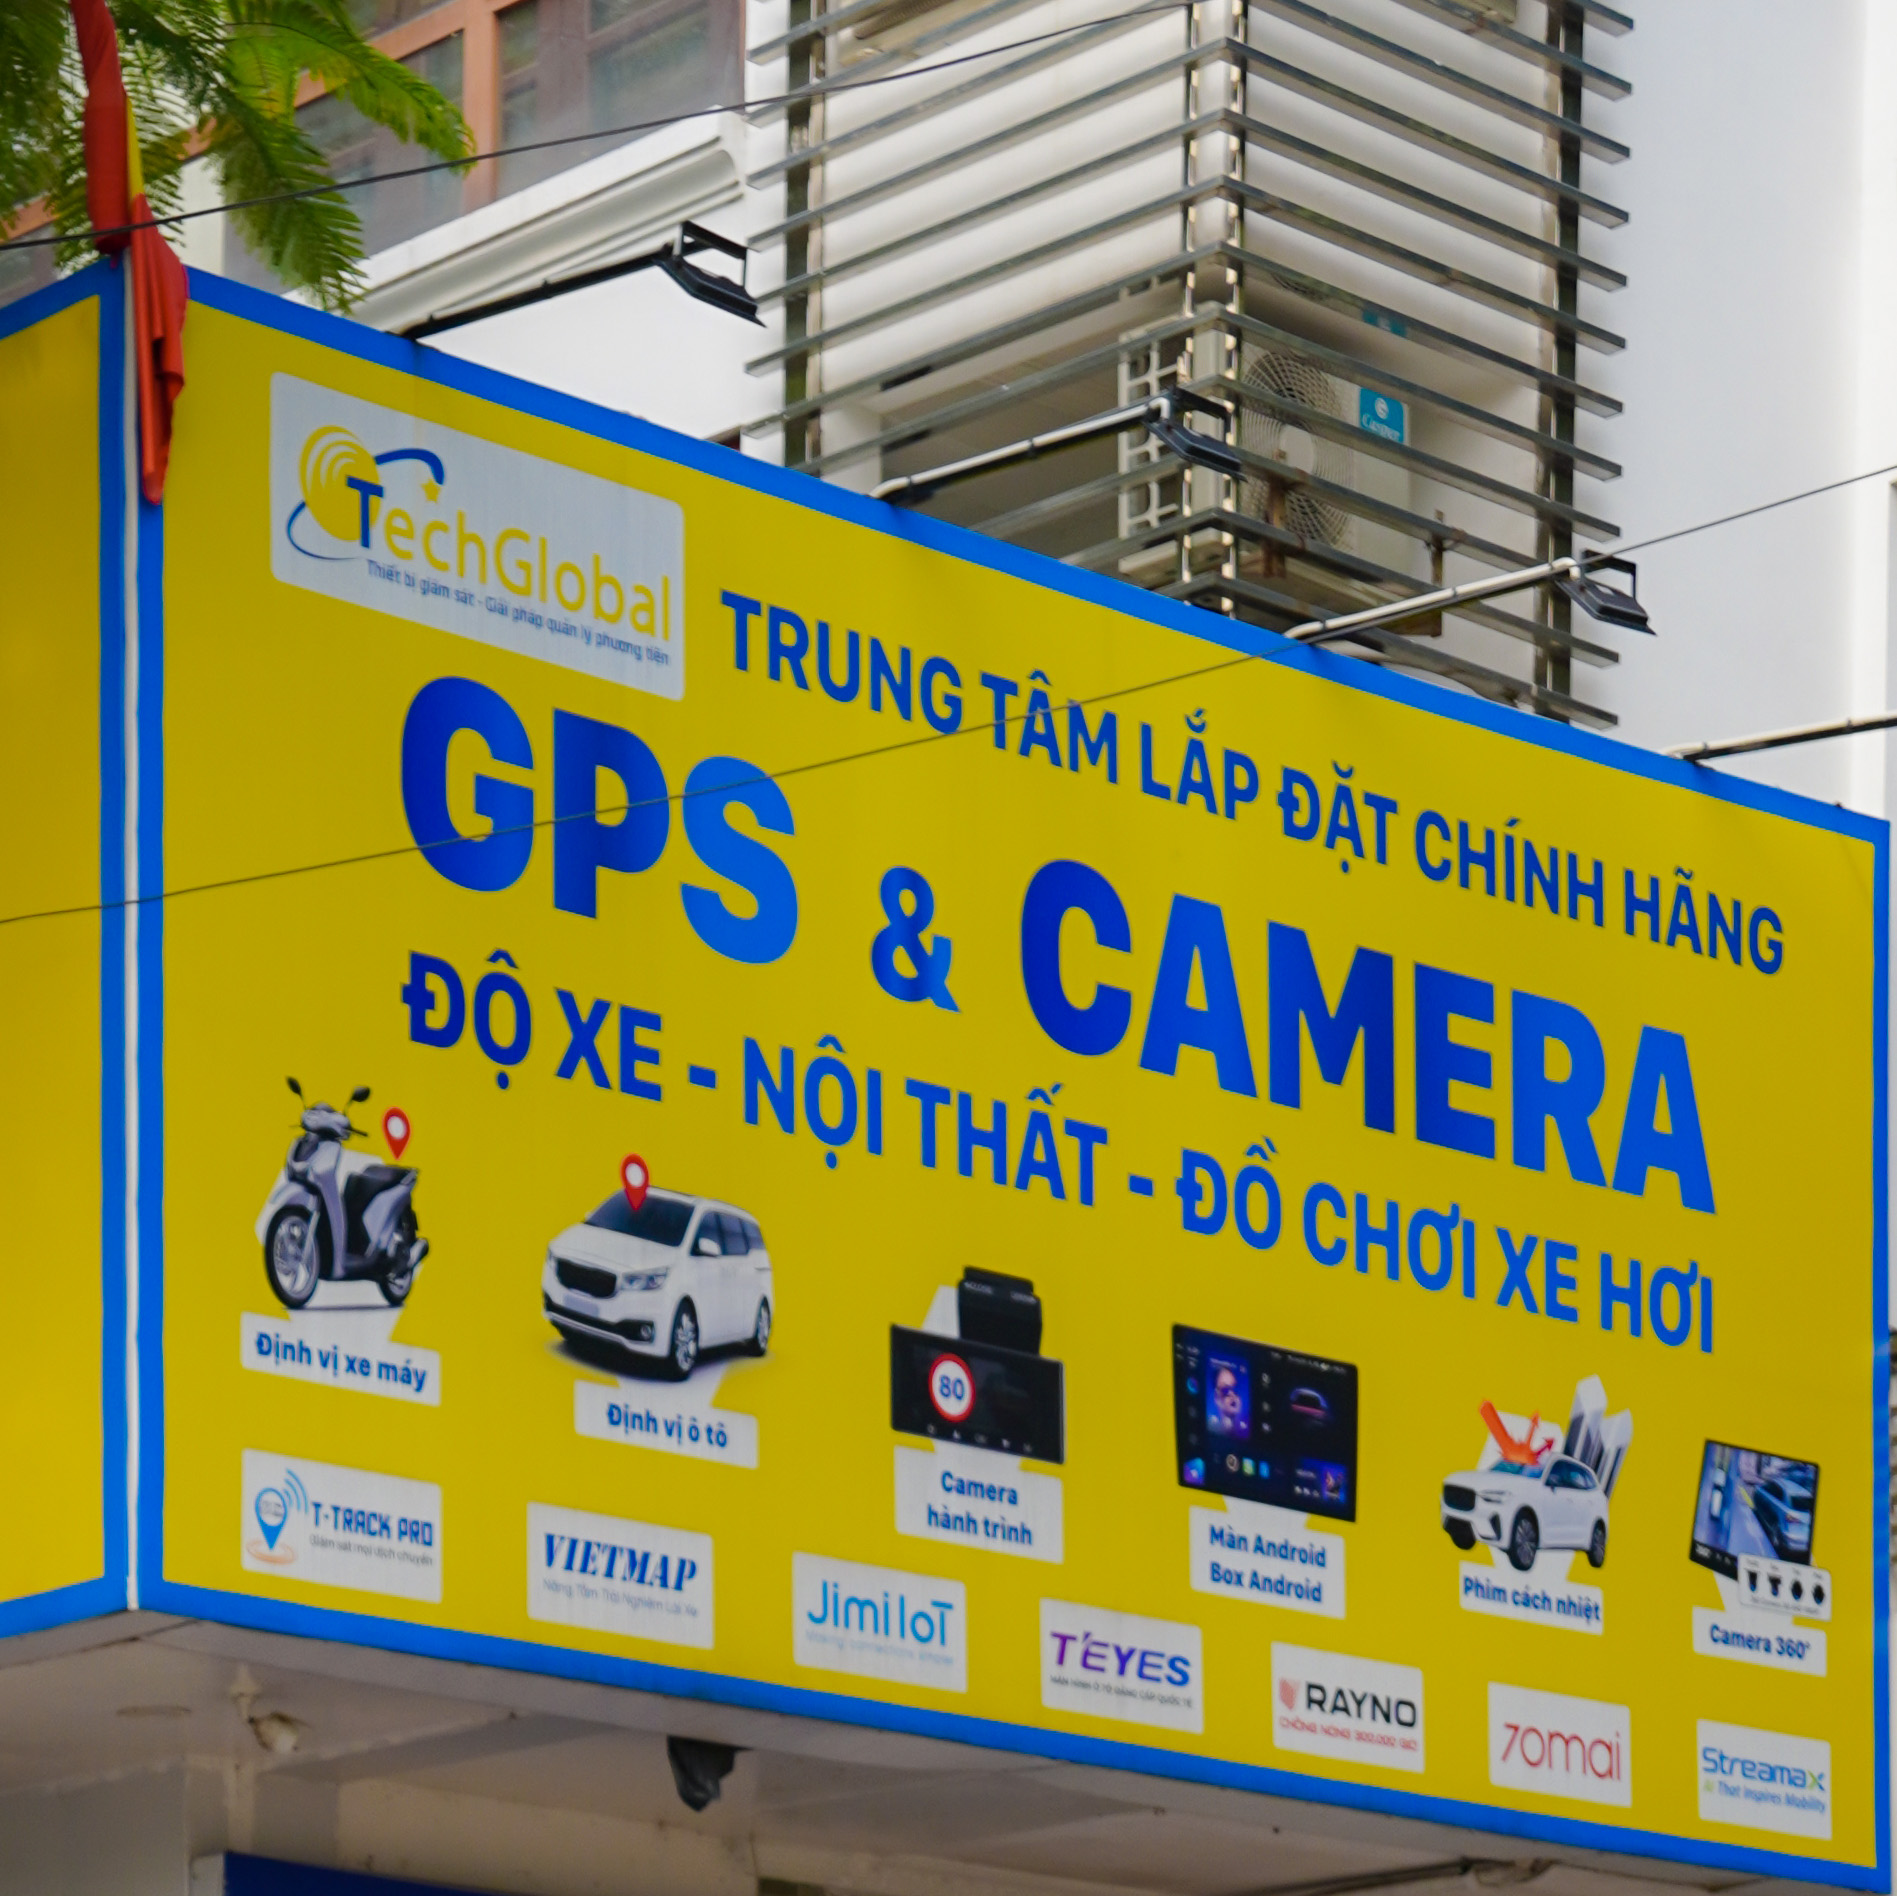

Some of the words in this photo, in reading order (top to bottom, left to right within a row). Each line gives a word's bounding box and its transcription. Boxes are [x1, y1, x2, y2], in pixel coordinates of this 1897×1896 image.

[345, 475, 671, 642] TechGlobal
[721, 588, 963, 735] TRUNG
[980, 669, 1119, 786] TÂM
[1139, 707, 1260, 821] LẮP
[1278, 759, 1398, 874] ĐẶT
[1415, 817, 1605, 928] CHÍNH
[1624, 867, 1784, 976] HÃNG
[401, 675, 798, 965] GPS
[870, 865, 961, 1014] &
[1021, 859, 1716, 1214] CAMERA
[400, 949, 532, 1091] ĐỘ
[554, 987, 664, 1102] XE
[743, 1034, 883, 1172] NỘI
[904, 1077, 1108, 1207] THẤT
[1174, 1135, 1283, 1250] ĐỒ
[1304, 1182, 1477, 1299] CHƠI
[1495, 1226, 1579, 1323] XE
[1599, 1252, 1714, 1354] HƠI
[255, 1331, 311, 1368] Định
[318, 1348, 340, 1378] vị
[344, 1355, 371, 1377] xe
[377, 1355, 427, 1392] máy
[939, 1374, 965, 1401] 80
[607, 1402, 659, 1438] Định
[664, 1417, 683, 1445] vị
[688, 1418, 701, 1443] ô
[704, 1415, 728, 1449] tô
[940, 1471, 1019, 1506] Camera
[312, 1501, 392, 1539] T-TRACK
[398, 1518, 433, 1547] PRO
[926, 1505, 978, 1539] hành
[982, 1516, 1033, 1546] trình
[1210, 1524, 1249, 1554] Màn
[1254, 1535, 1327, 1569] Android
[544, 1532, 697, 1592] VIETMAP
[1210, 1562, 1245, 1589] Box
[1249, 1568, 1322, 1604] Android
[1463, 1575, 1507, 1604] Phim
[1512, 1583, 1553, 1612] cách
[1556, 1589, 1602, 1625] nhiệt
[1710, 1624, 1771, 1653] Camera
[1306, 1681, 1416, 1728] RAYNO
[1501, 1723, 1622, 1782] 70mai
[1702, 1747, 1825, 1791] Streamax
